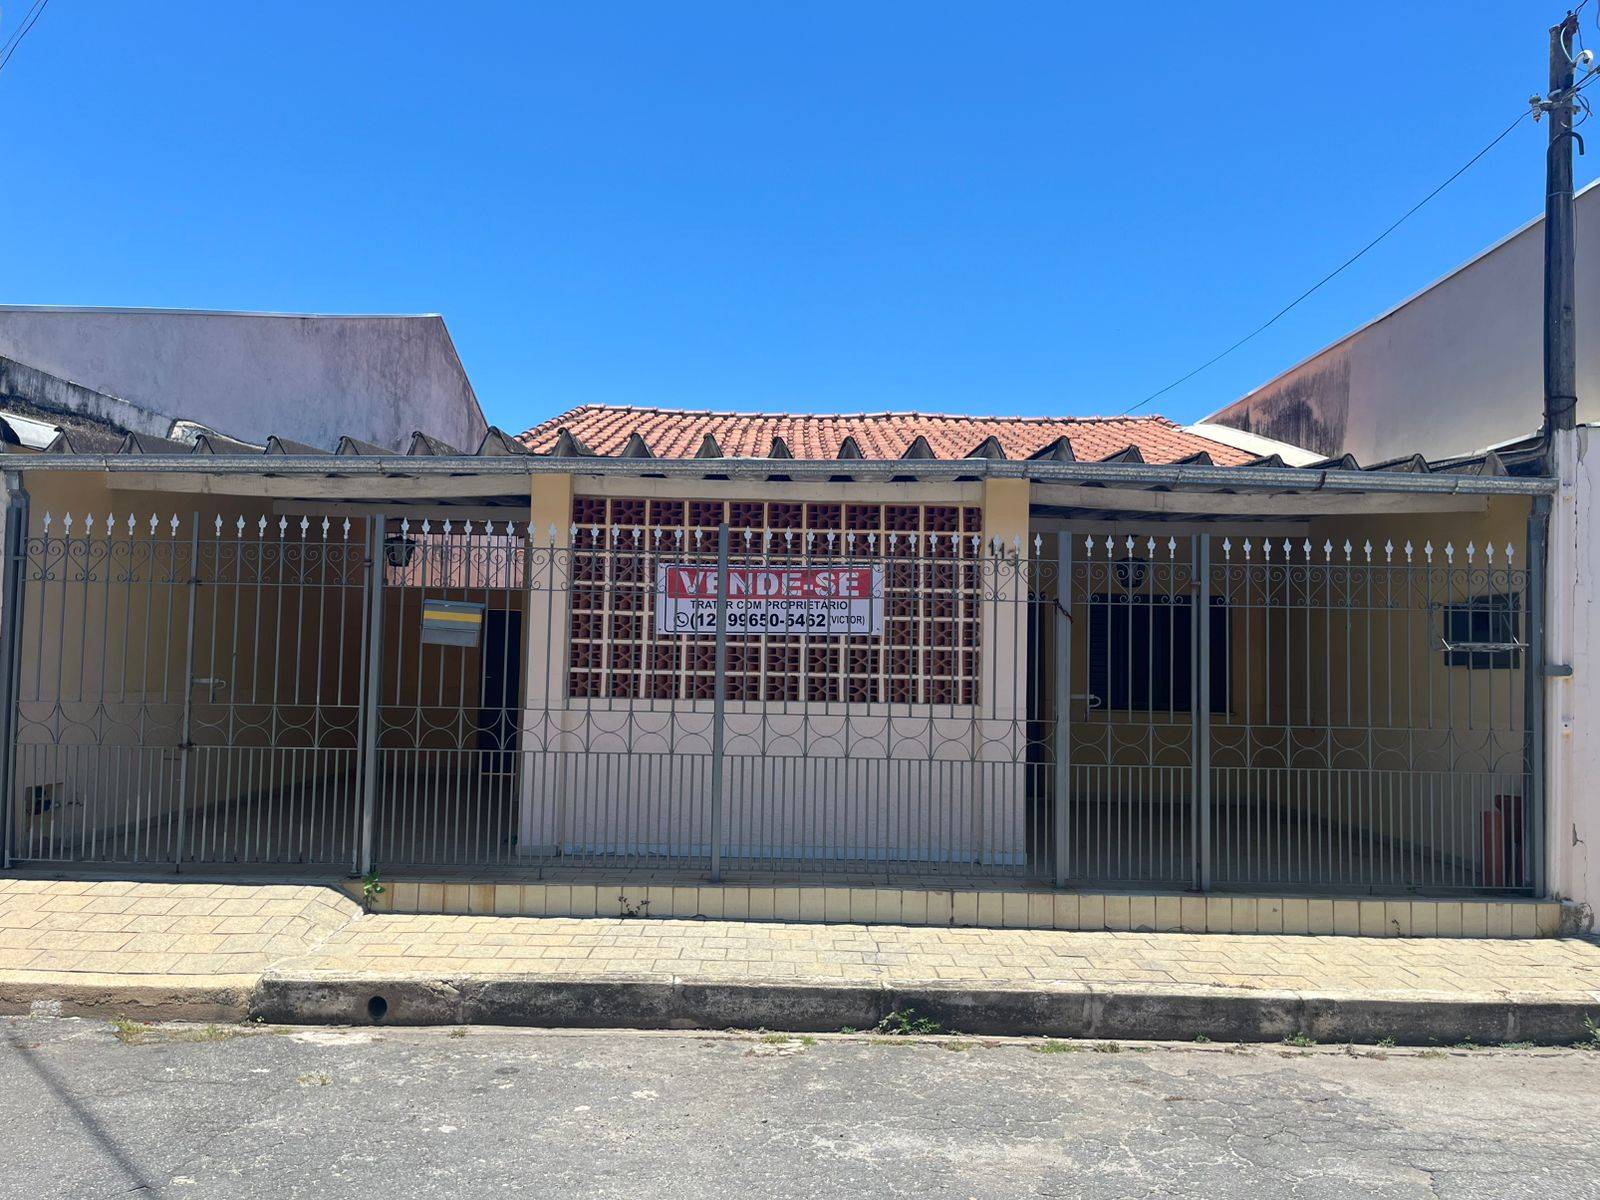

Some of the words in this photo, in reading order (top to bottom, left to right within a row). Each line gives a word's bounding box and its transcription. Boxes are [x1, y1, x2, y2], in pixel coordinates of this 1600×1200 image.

[679, 570, 859, 597] VENDE-SE
[690, 600, 734, 610] TRATR
[736, 600, 762, 610] COM
[690, 613, 725, 630] (12
